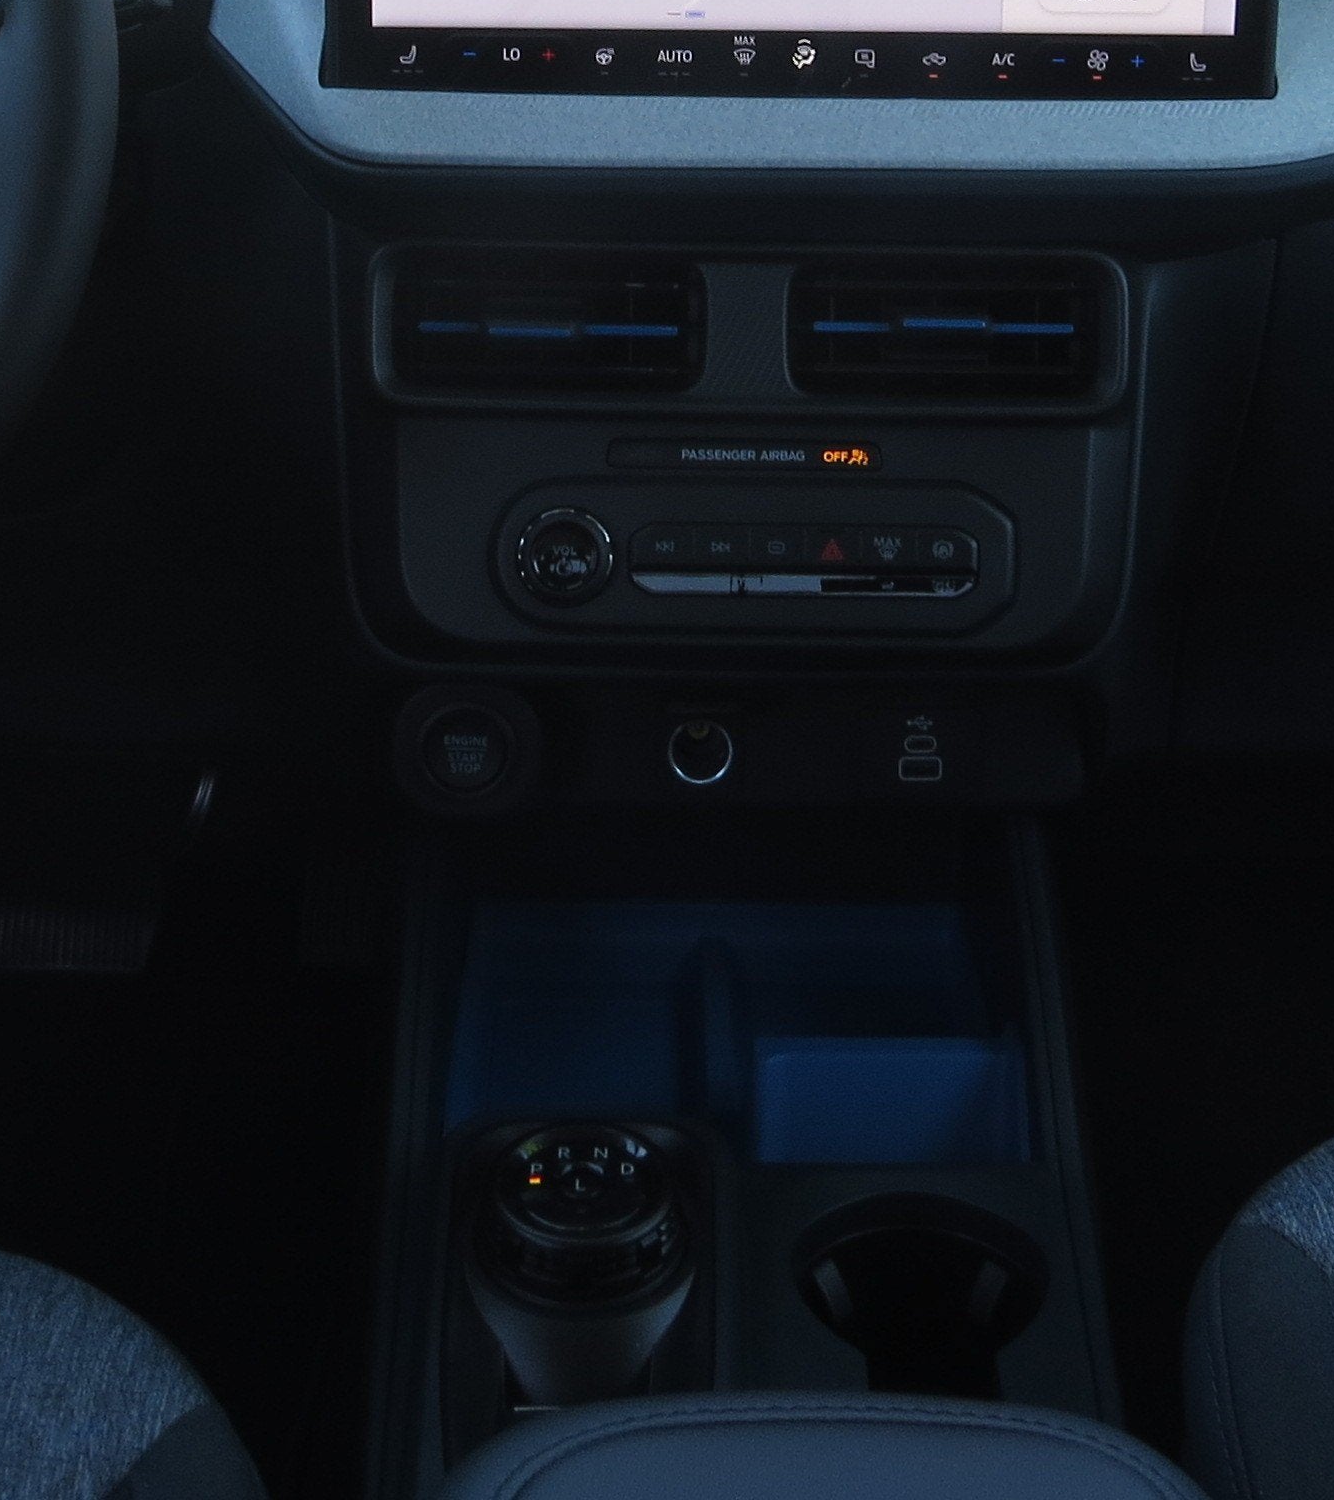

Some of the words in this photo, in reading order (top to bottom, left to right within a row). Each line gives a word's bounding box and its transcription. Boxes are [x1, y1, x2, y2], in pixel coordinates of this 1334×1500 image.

[733, 35, 756, 46] MAX
[502, 48, 521, 62] LO
[657, 49, 693, 63] AUTO
[991, 52, 1015, 67] A/C
[681, 448, 757, 462] PASSENGER
[760, 449, 806, 463] AIRBAG
[822, 450, 849, 464] OFF
[443, 734, 489, 747] ENGINE
[558, 1147, 571, 1159] R
[594, 1147, 609, 1159] N
[621, 1162, 635, 1175] D
[575, 1178, 586, 1191] L
